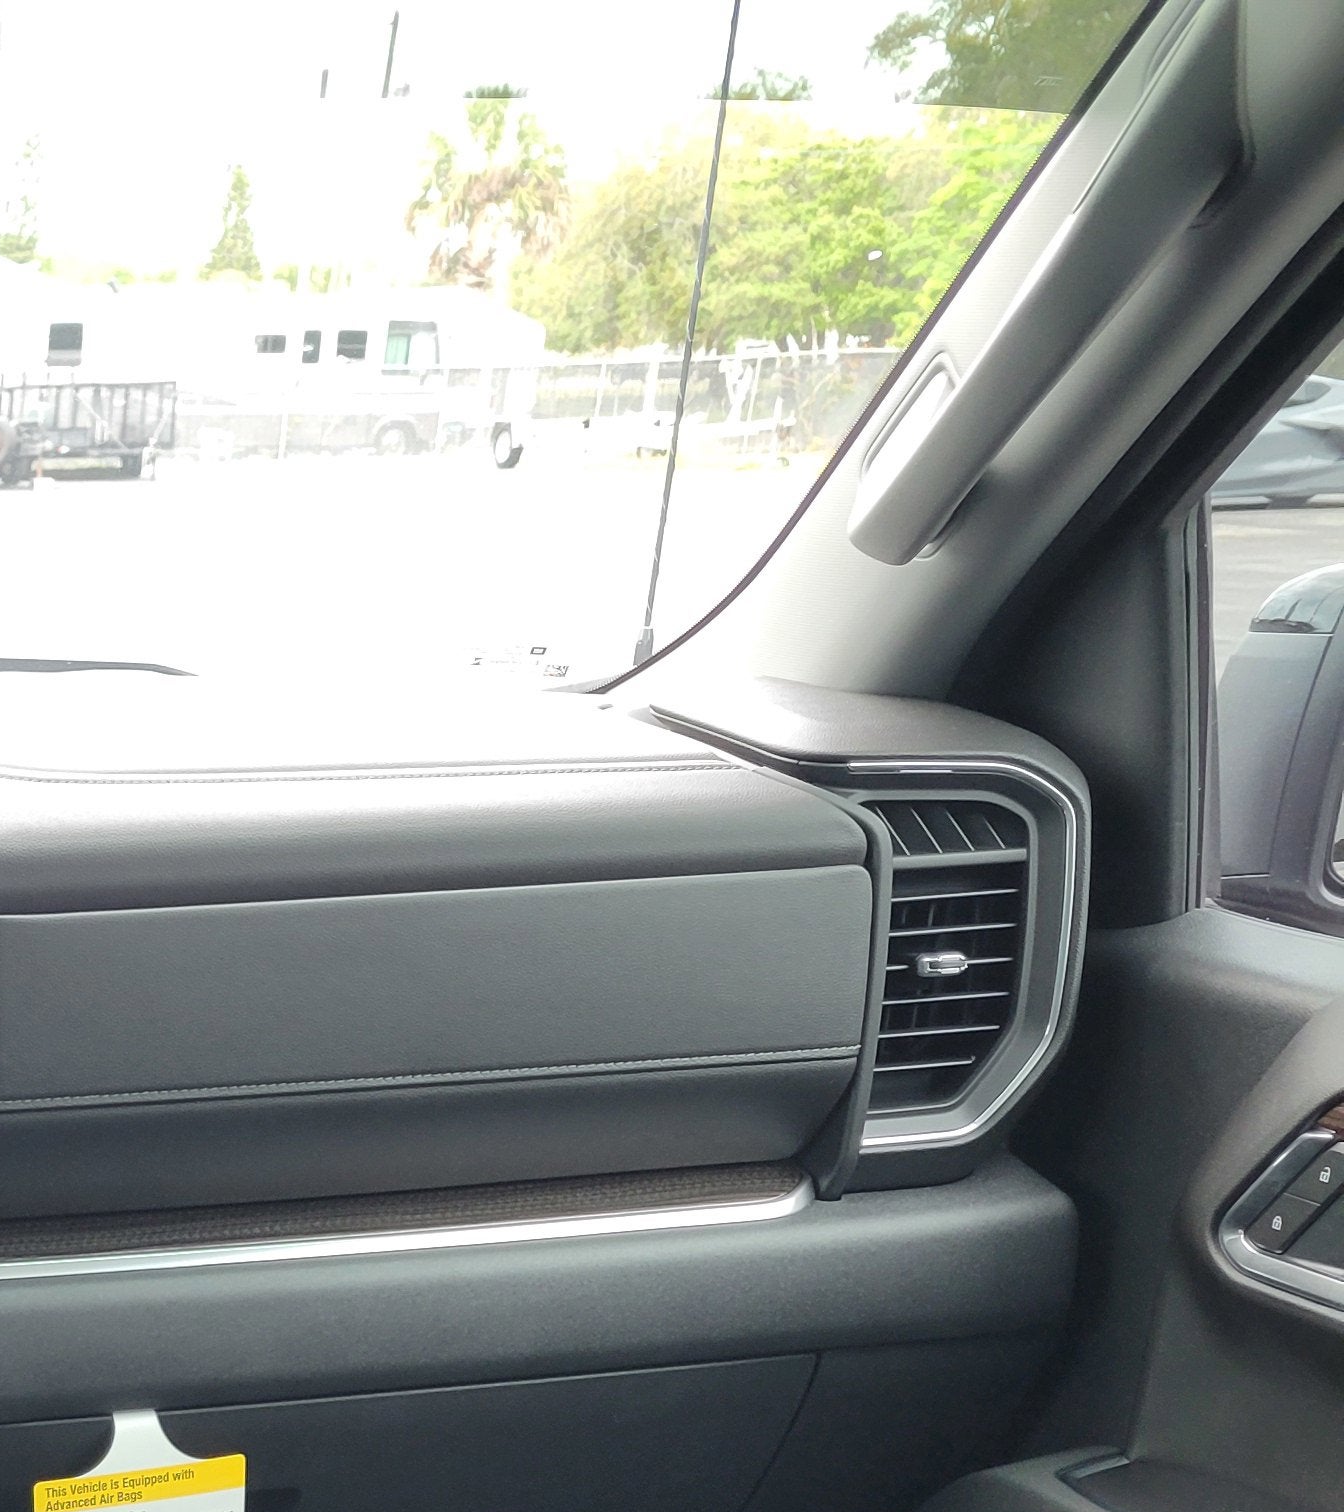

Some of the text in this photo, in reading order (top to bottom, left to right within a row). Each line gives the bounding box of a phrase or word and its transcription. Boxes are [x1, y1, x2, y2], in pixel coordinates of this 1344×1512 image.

[45, 1468, 195, 1498] This Vehicle is Equipped with
[45, 1491, 143, 1512] Advanced Air Bags
